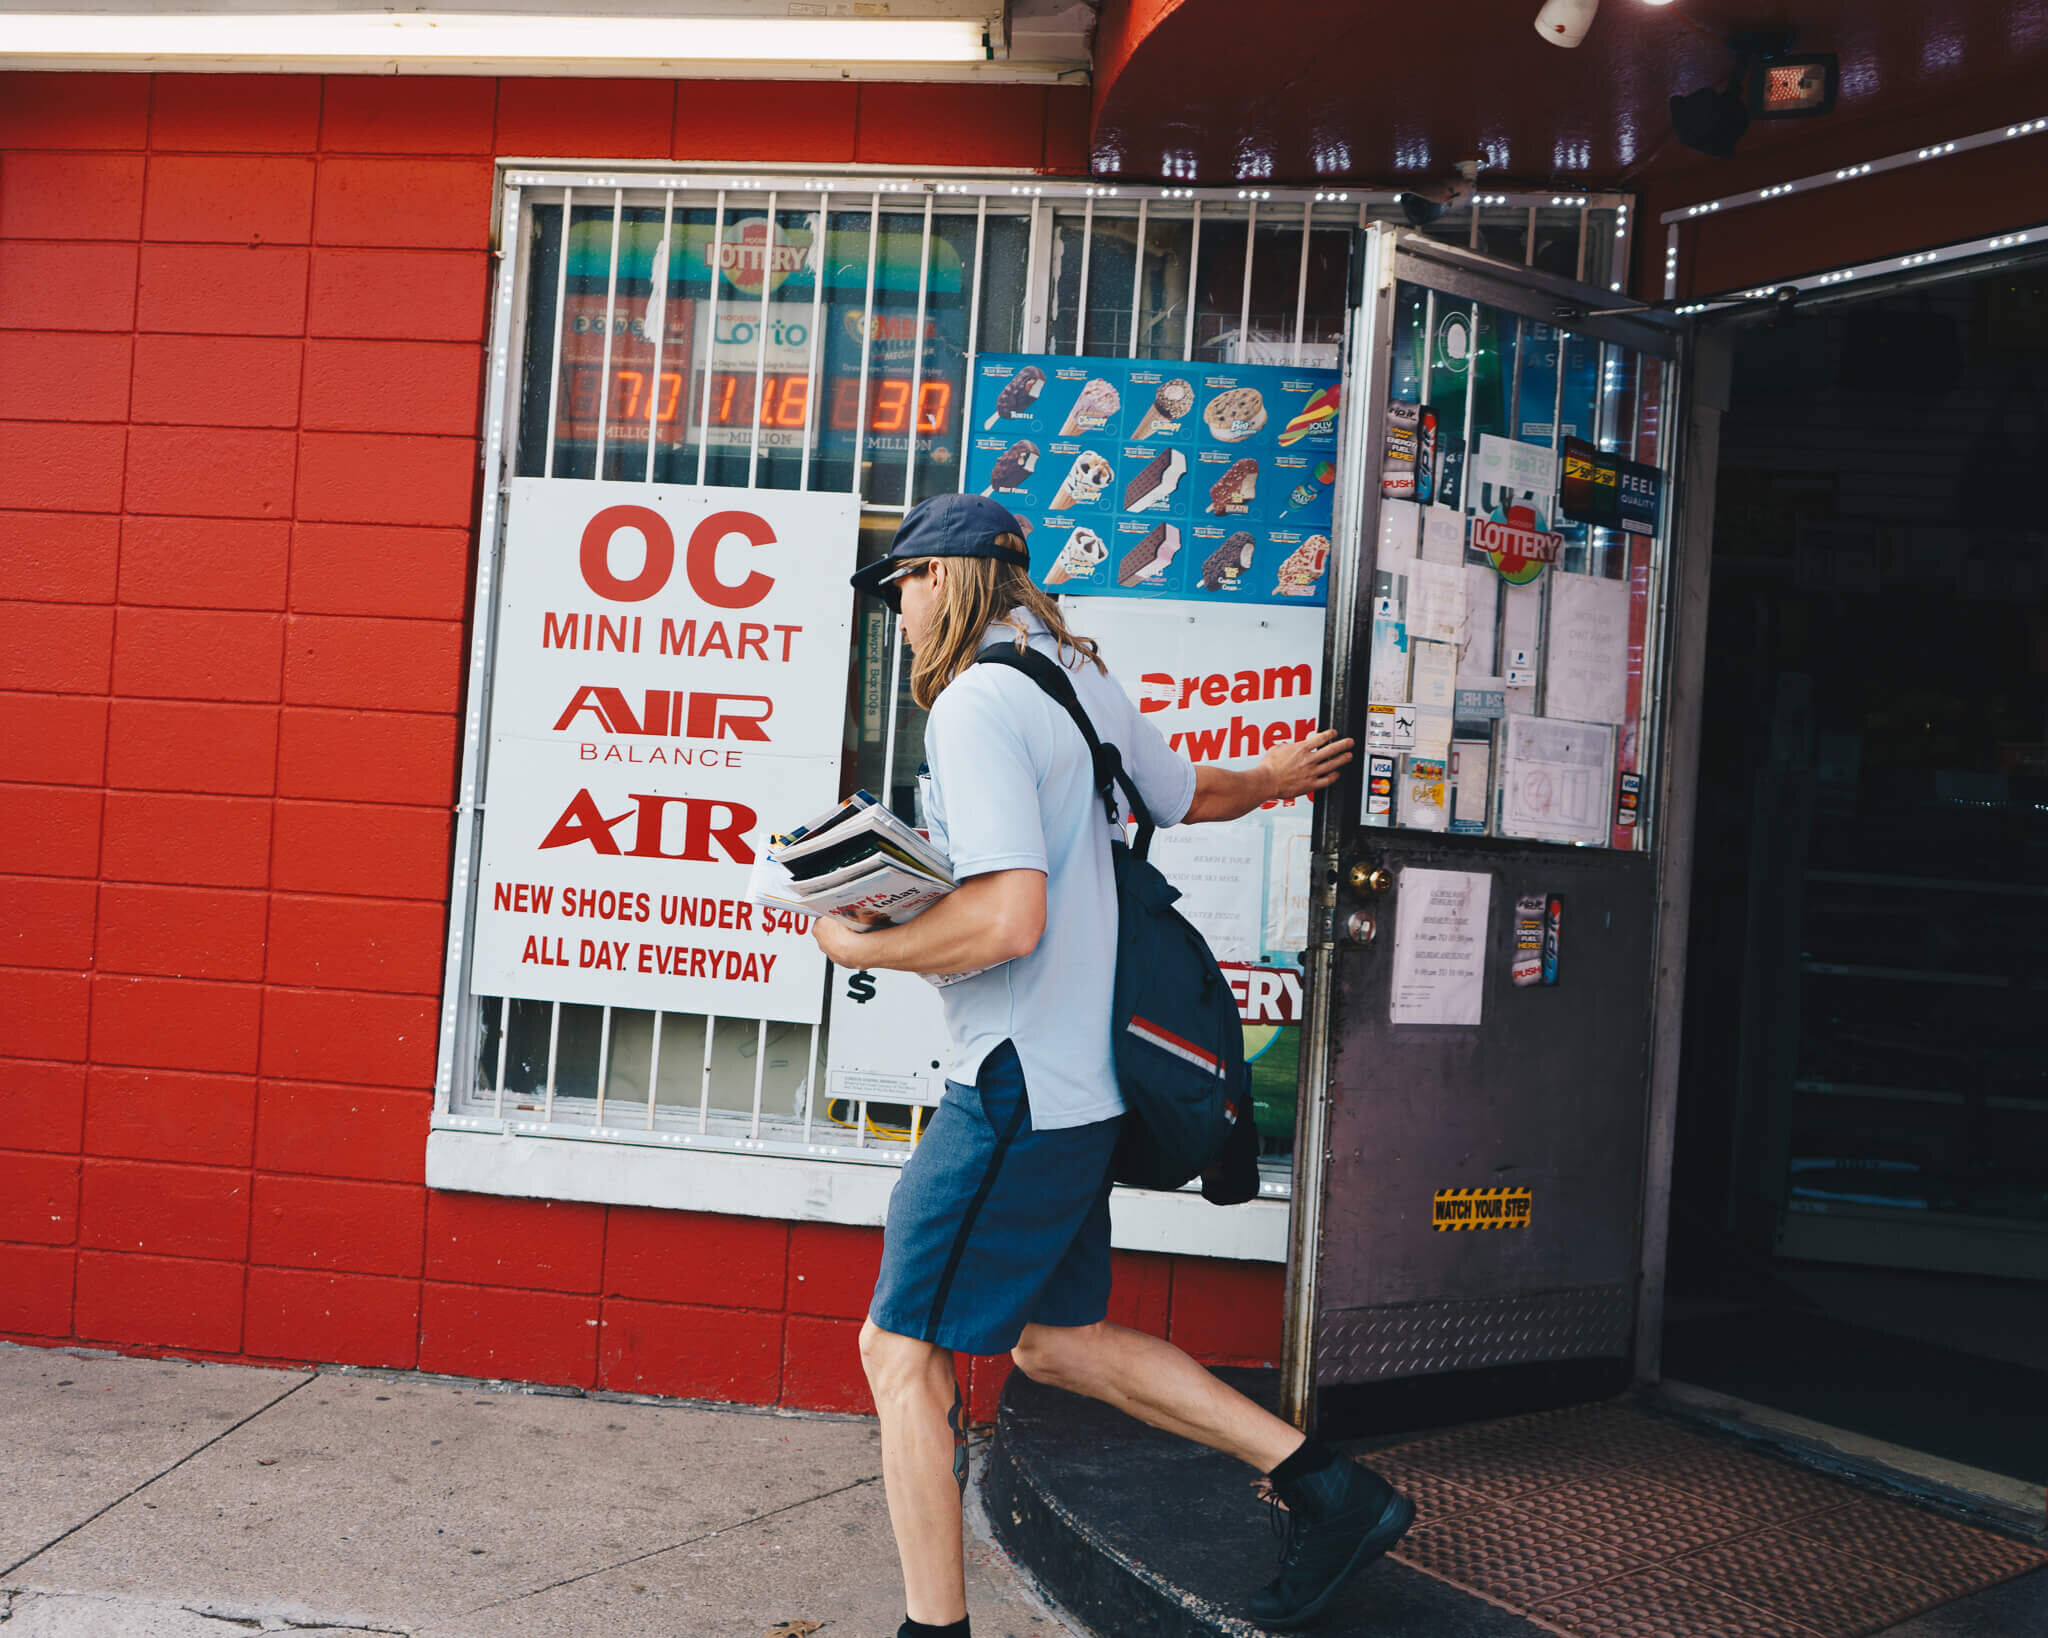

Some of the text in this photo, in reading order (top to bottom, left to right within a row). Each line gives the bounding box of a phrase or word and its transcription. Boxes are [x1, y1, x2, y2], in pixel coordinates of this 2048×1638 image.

[616, 371, 682, 421] 70
[872, 380, 951, 432] 30
[1383, 480, 1415, 489] PUSH
[1620, 494, 1656, 509] QUALITY
[1622, 474, 1655, 496] FEEL
[579, 504, 778, 610] OC
[1475, 519, 1560, 562] LOTTERY
[542, 611, 803, 662] MINI MART
[1140, 663, 1312, 714] Dream
[580, 743, 743, 768] BALANCE
[1374, 763, 1392, 773] VISA
[537, 788, 758, 865] AIR
[493, 882, 809, 936] NEW SHOES UNDER $40
[872, 886, 921, 908] today
[522, 935, 777, 983] ALL DAY EVERYDAY
[1513, 965, 1542, 979] PUSH
[1436, 1198, 1530, 1220] WATCH YOUR STEP
